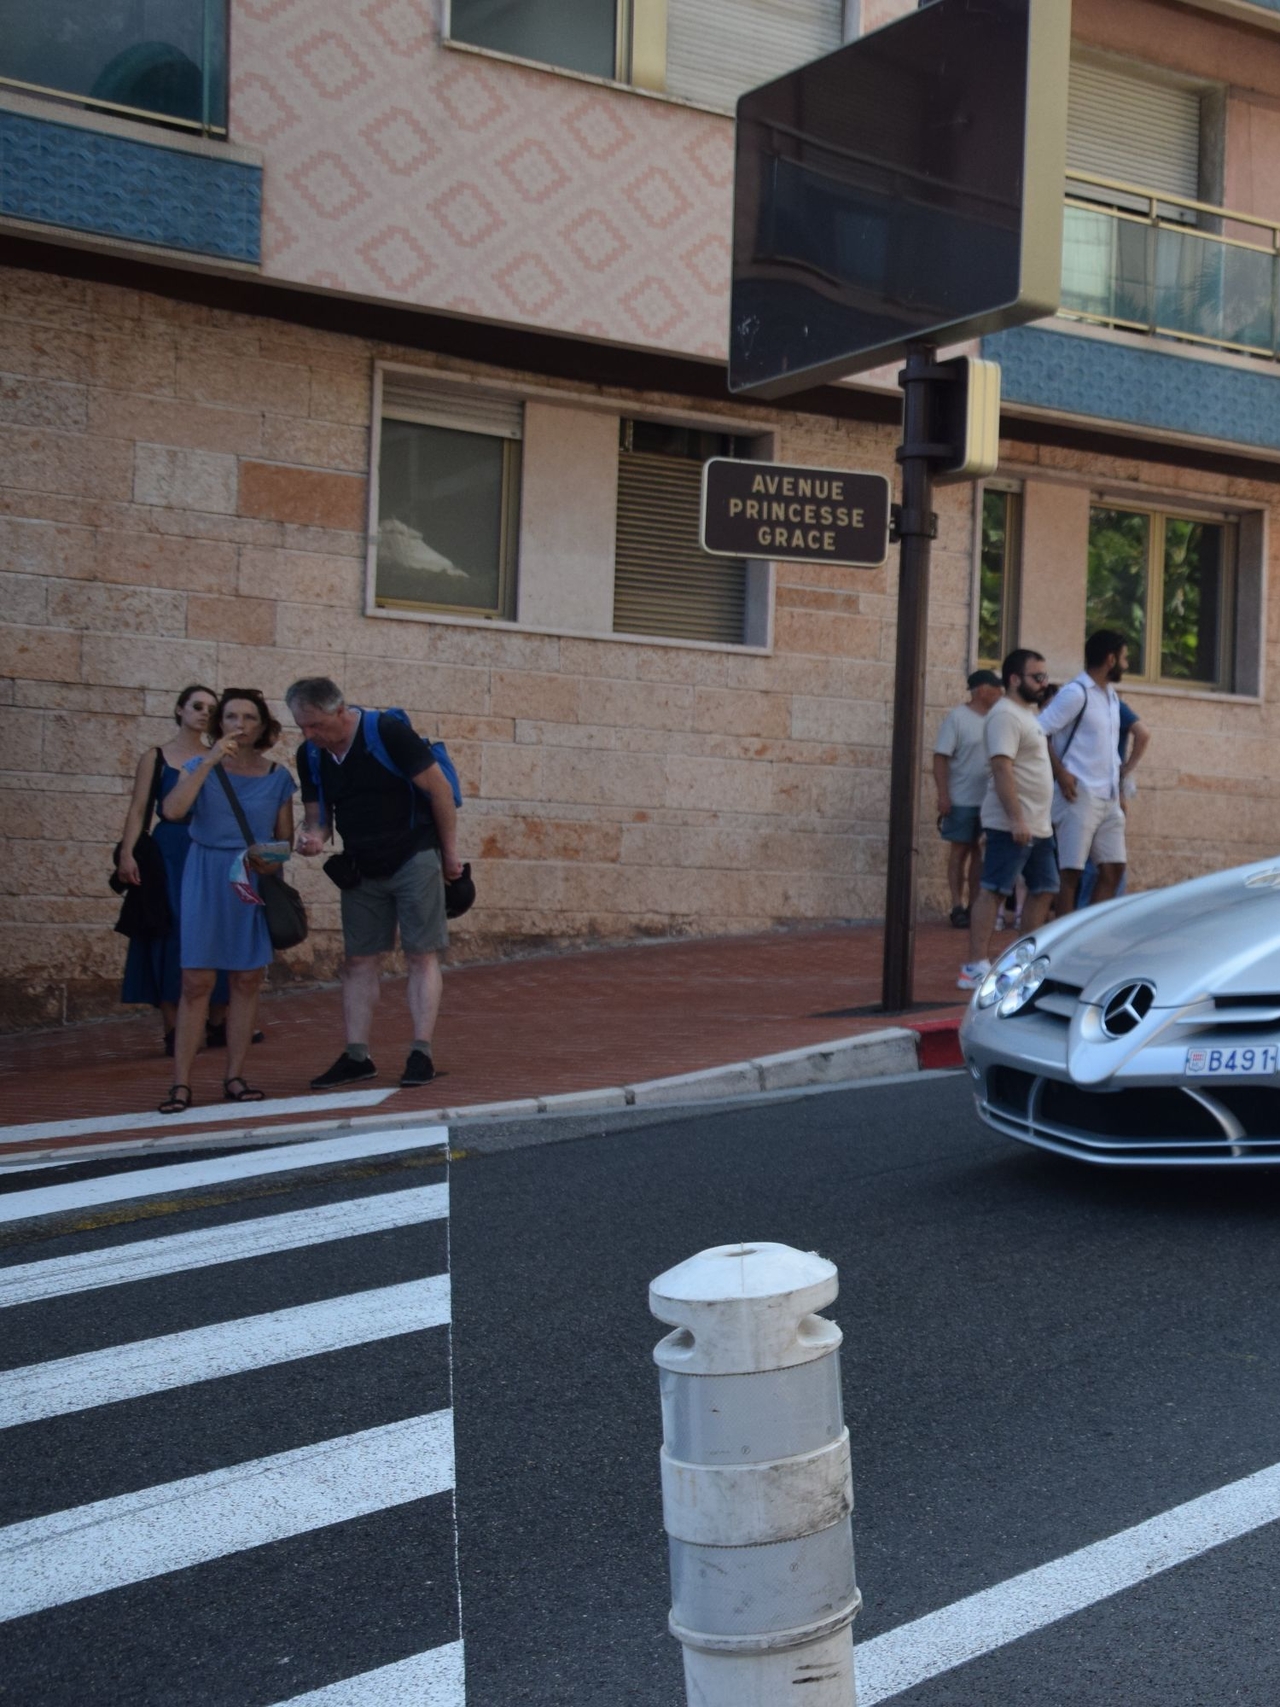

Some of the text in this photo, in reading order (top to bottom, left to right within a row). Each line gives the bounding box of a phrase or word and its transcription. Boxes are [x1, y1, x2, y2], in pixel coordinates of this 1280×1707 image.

[752, 474, 844, 500] AVENUE
[729, 499, 865, 528] PRINCESSE
[758, 526, 836, 550] GRACE
[1208, 1049, 1269, 1072] B491
